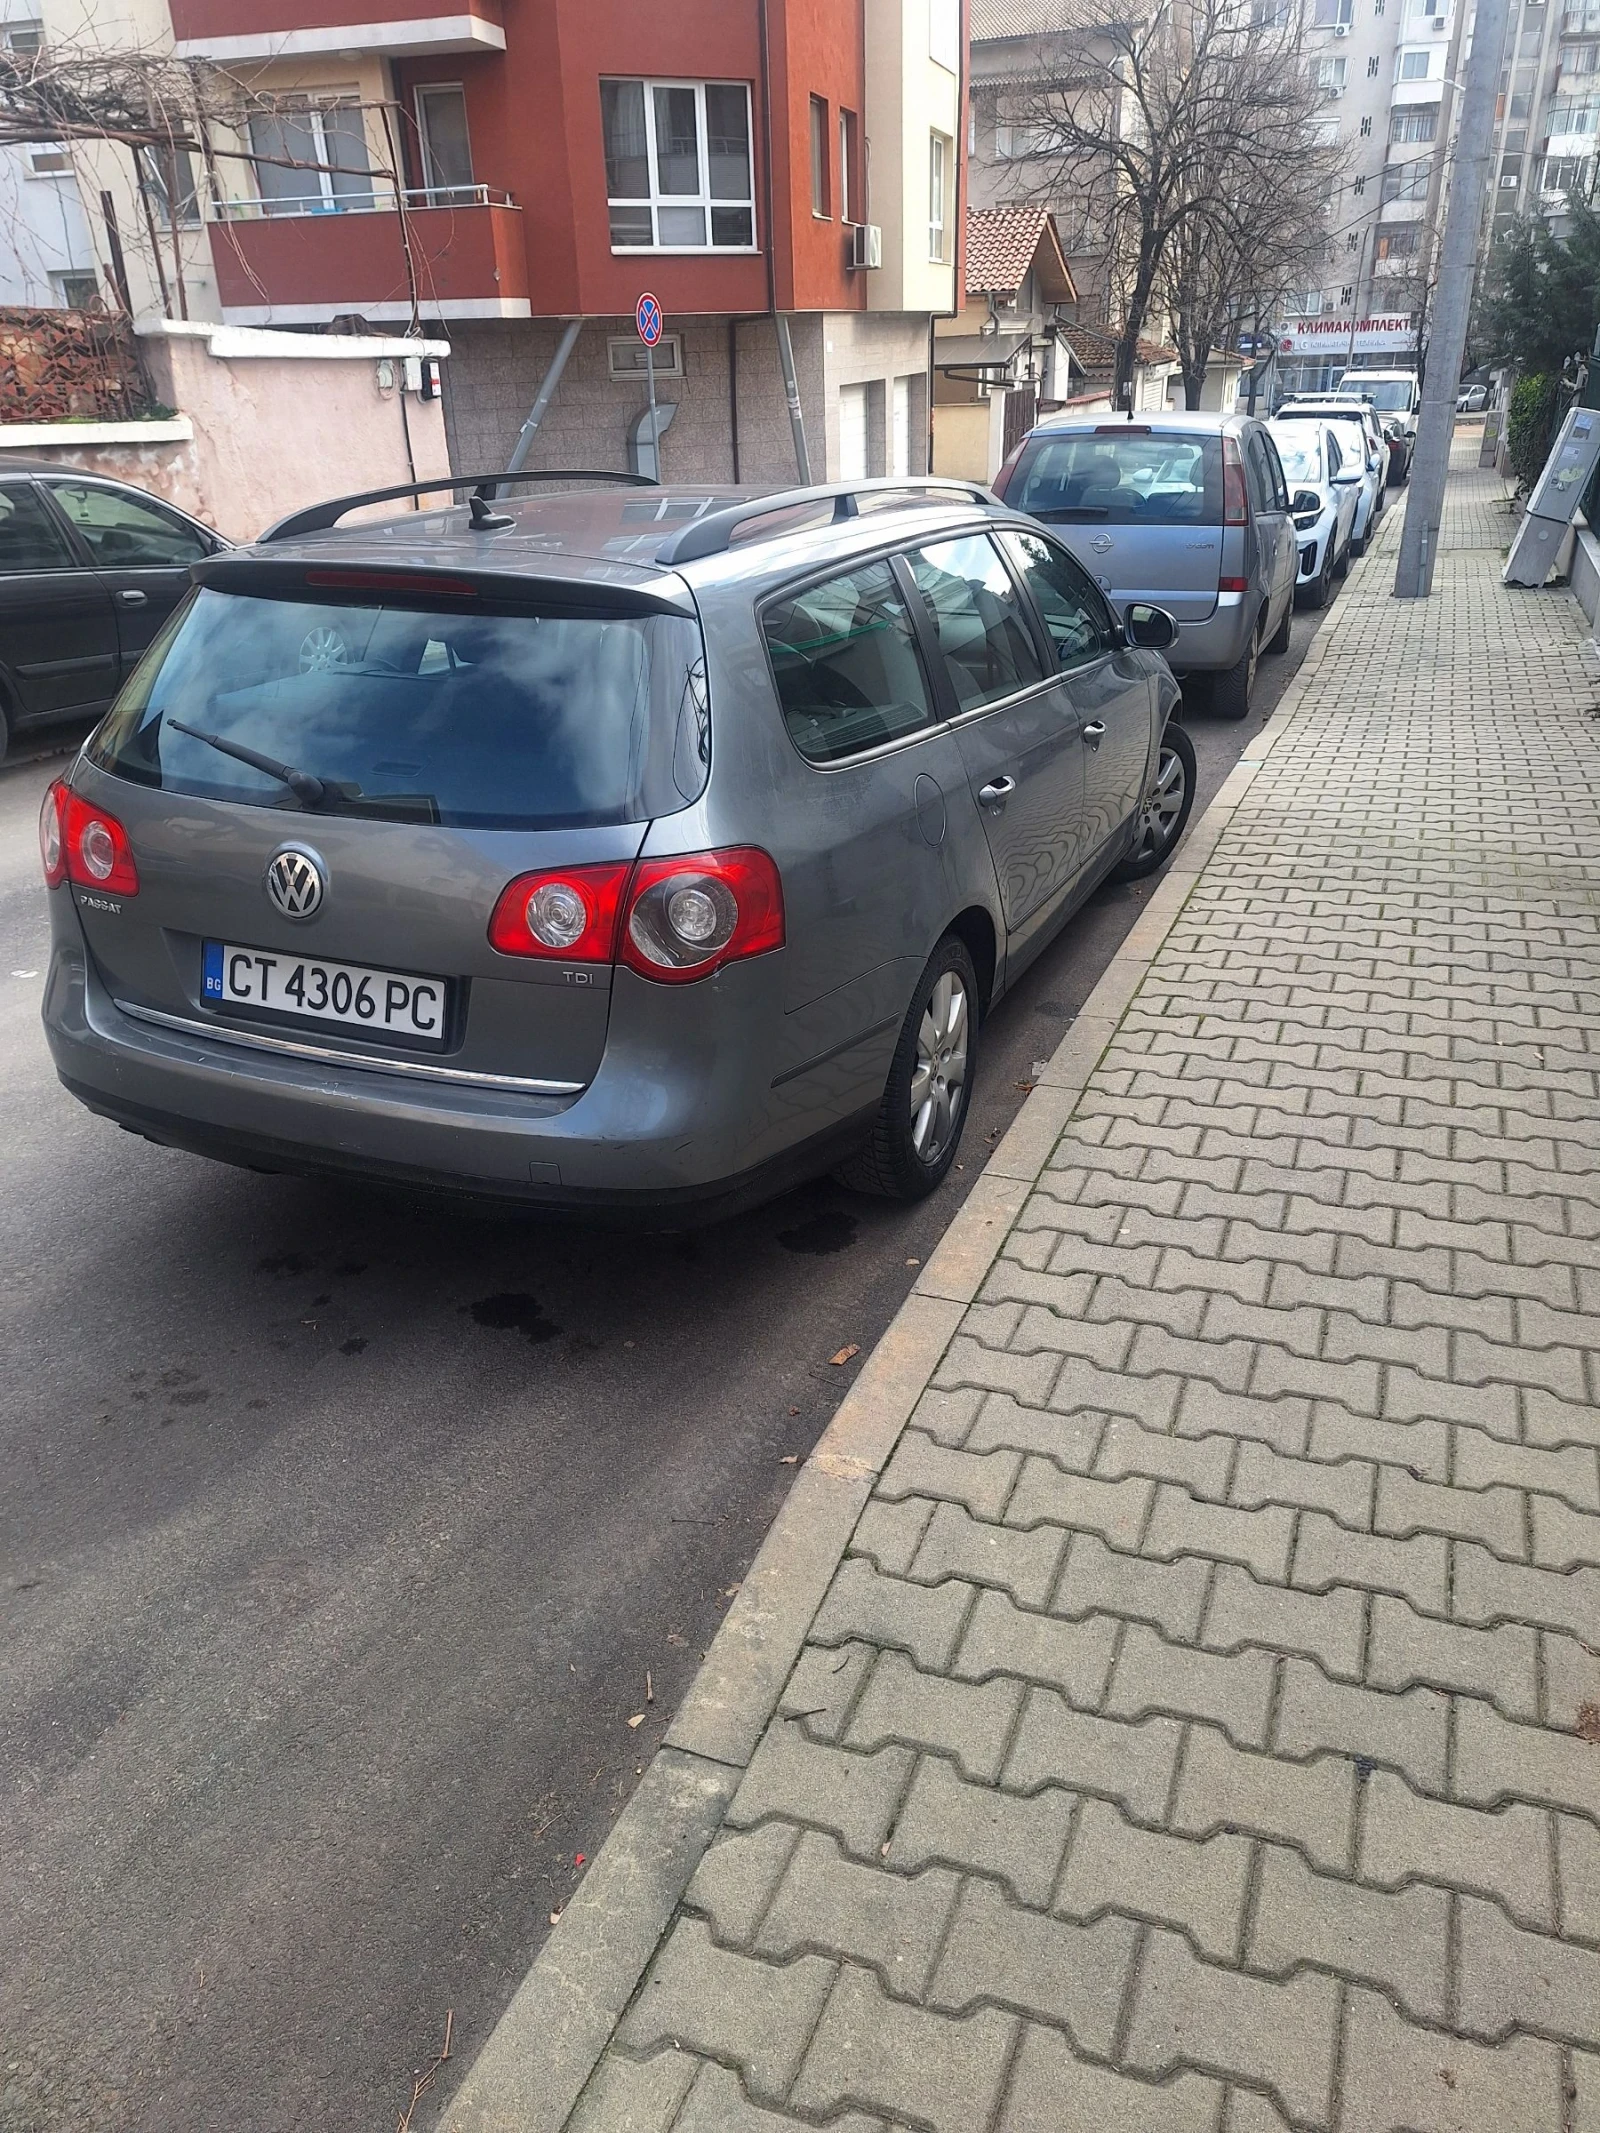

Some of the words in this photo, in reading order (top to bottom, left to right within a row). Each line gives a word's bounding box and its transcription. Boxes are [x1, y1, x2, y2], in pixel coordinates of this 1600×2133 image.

[80, 895, 122, 915] PASSAT
[206, 976, 221, 991] BG
[562, 971, 593, 985] TDI
[229, 953, 277, 1001] CT
[285, 964, 375, 1019] 4306
[385, 980, 437, 1030] PC
